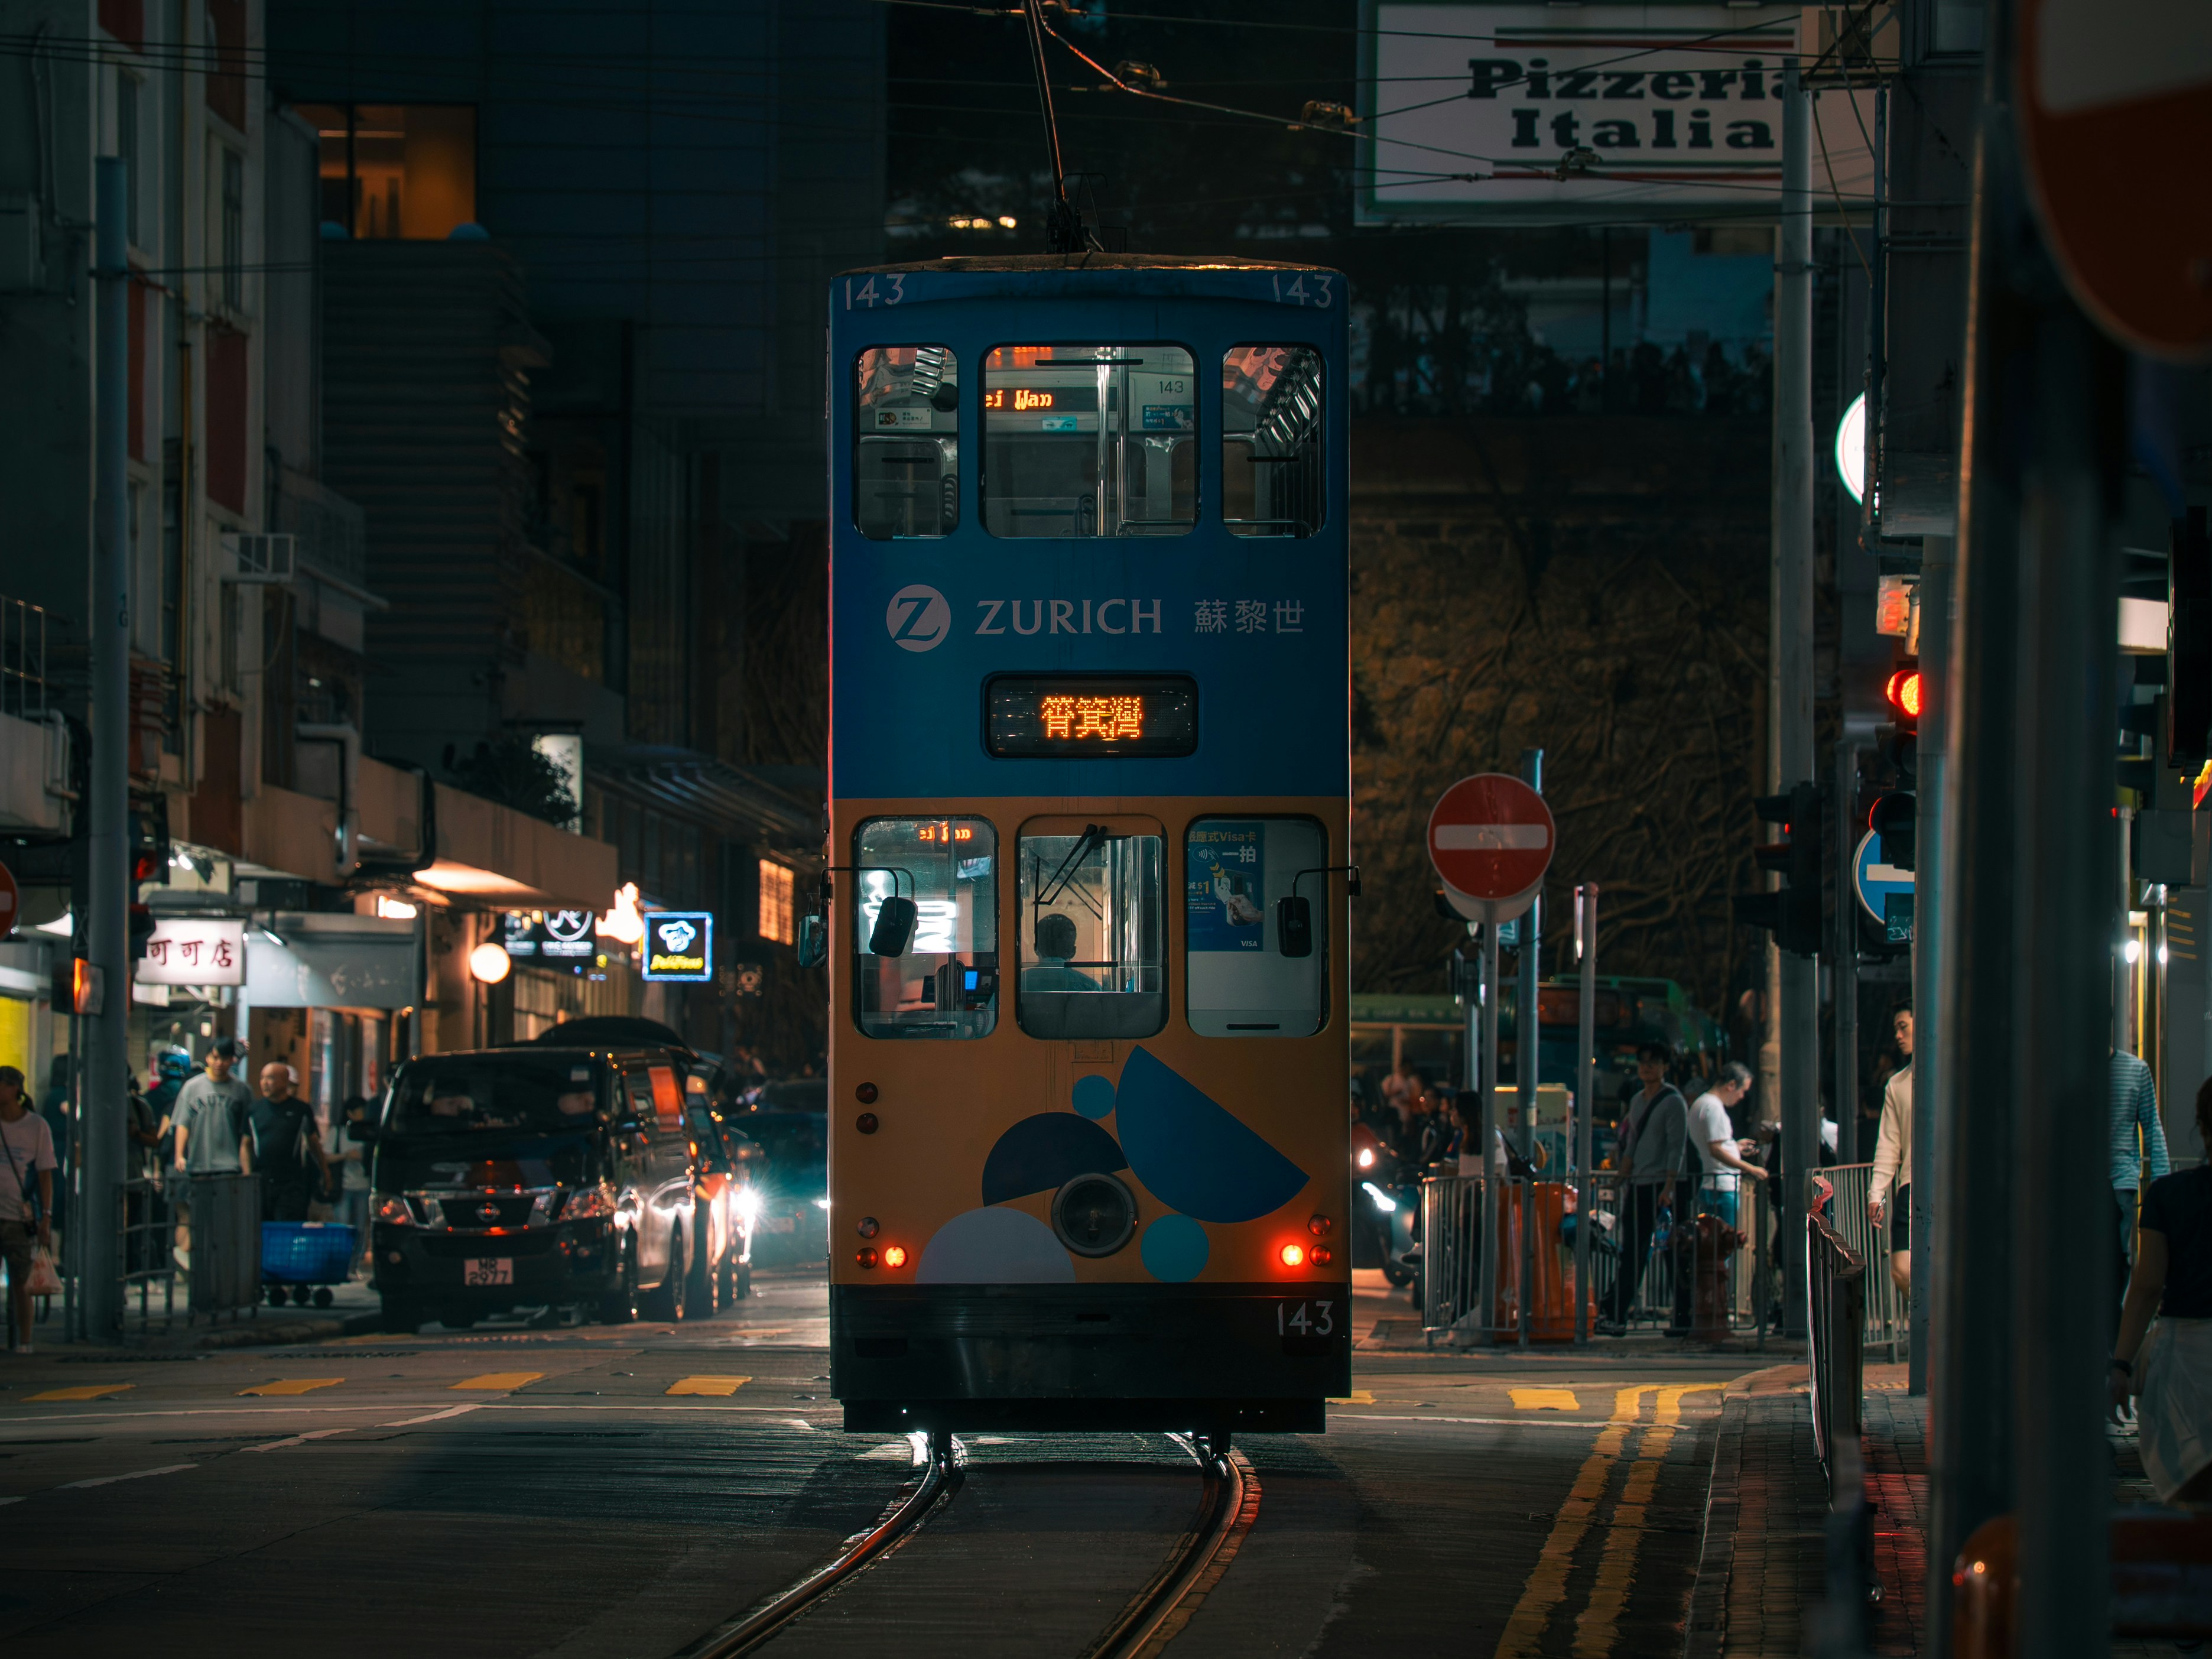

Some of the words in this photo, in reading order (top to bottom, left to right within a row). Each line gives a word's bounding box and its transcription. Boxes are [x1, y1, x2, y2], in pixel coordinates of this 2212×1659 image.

[1511, 109, 1775, 149] Italia
[844, 273, 906, 310] 143
[1272, 274, 1334, 309] 143
[1014, 389, 1053, 410] Wan
[1159, 380, 1184, 394] 143
[975, 599, 1162, 635] ZURICH
[1194, 599, 1305, 634] 蘇黎世
[1040, 696, 1144, 739] 筲箕灣
[1222, 845, 1257, 863] 一拍
[147, 937, 233, 968] 可可店
[1278, 1300, 1334, 1336] 143
